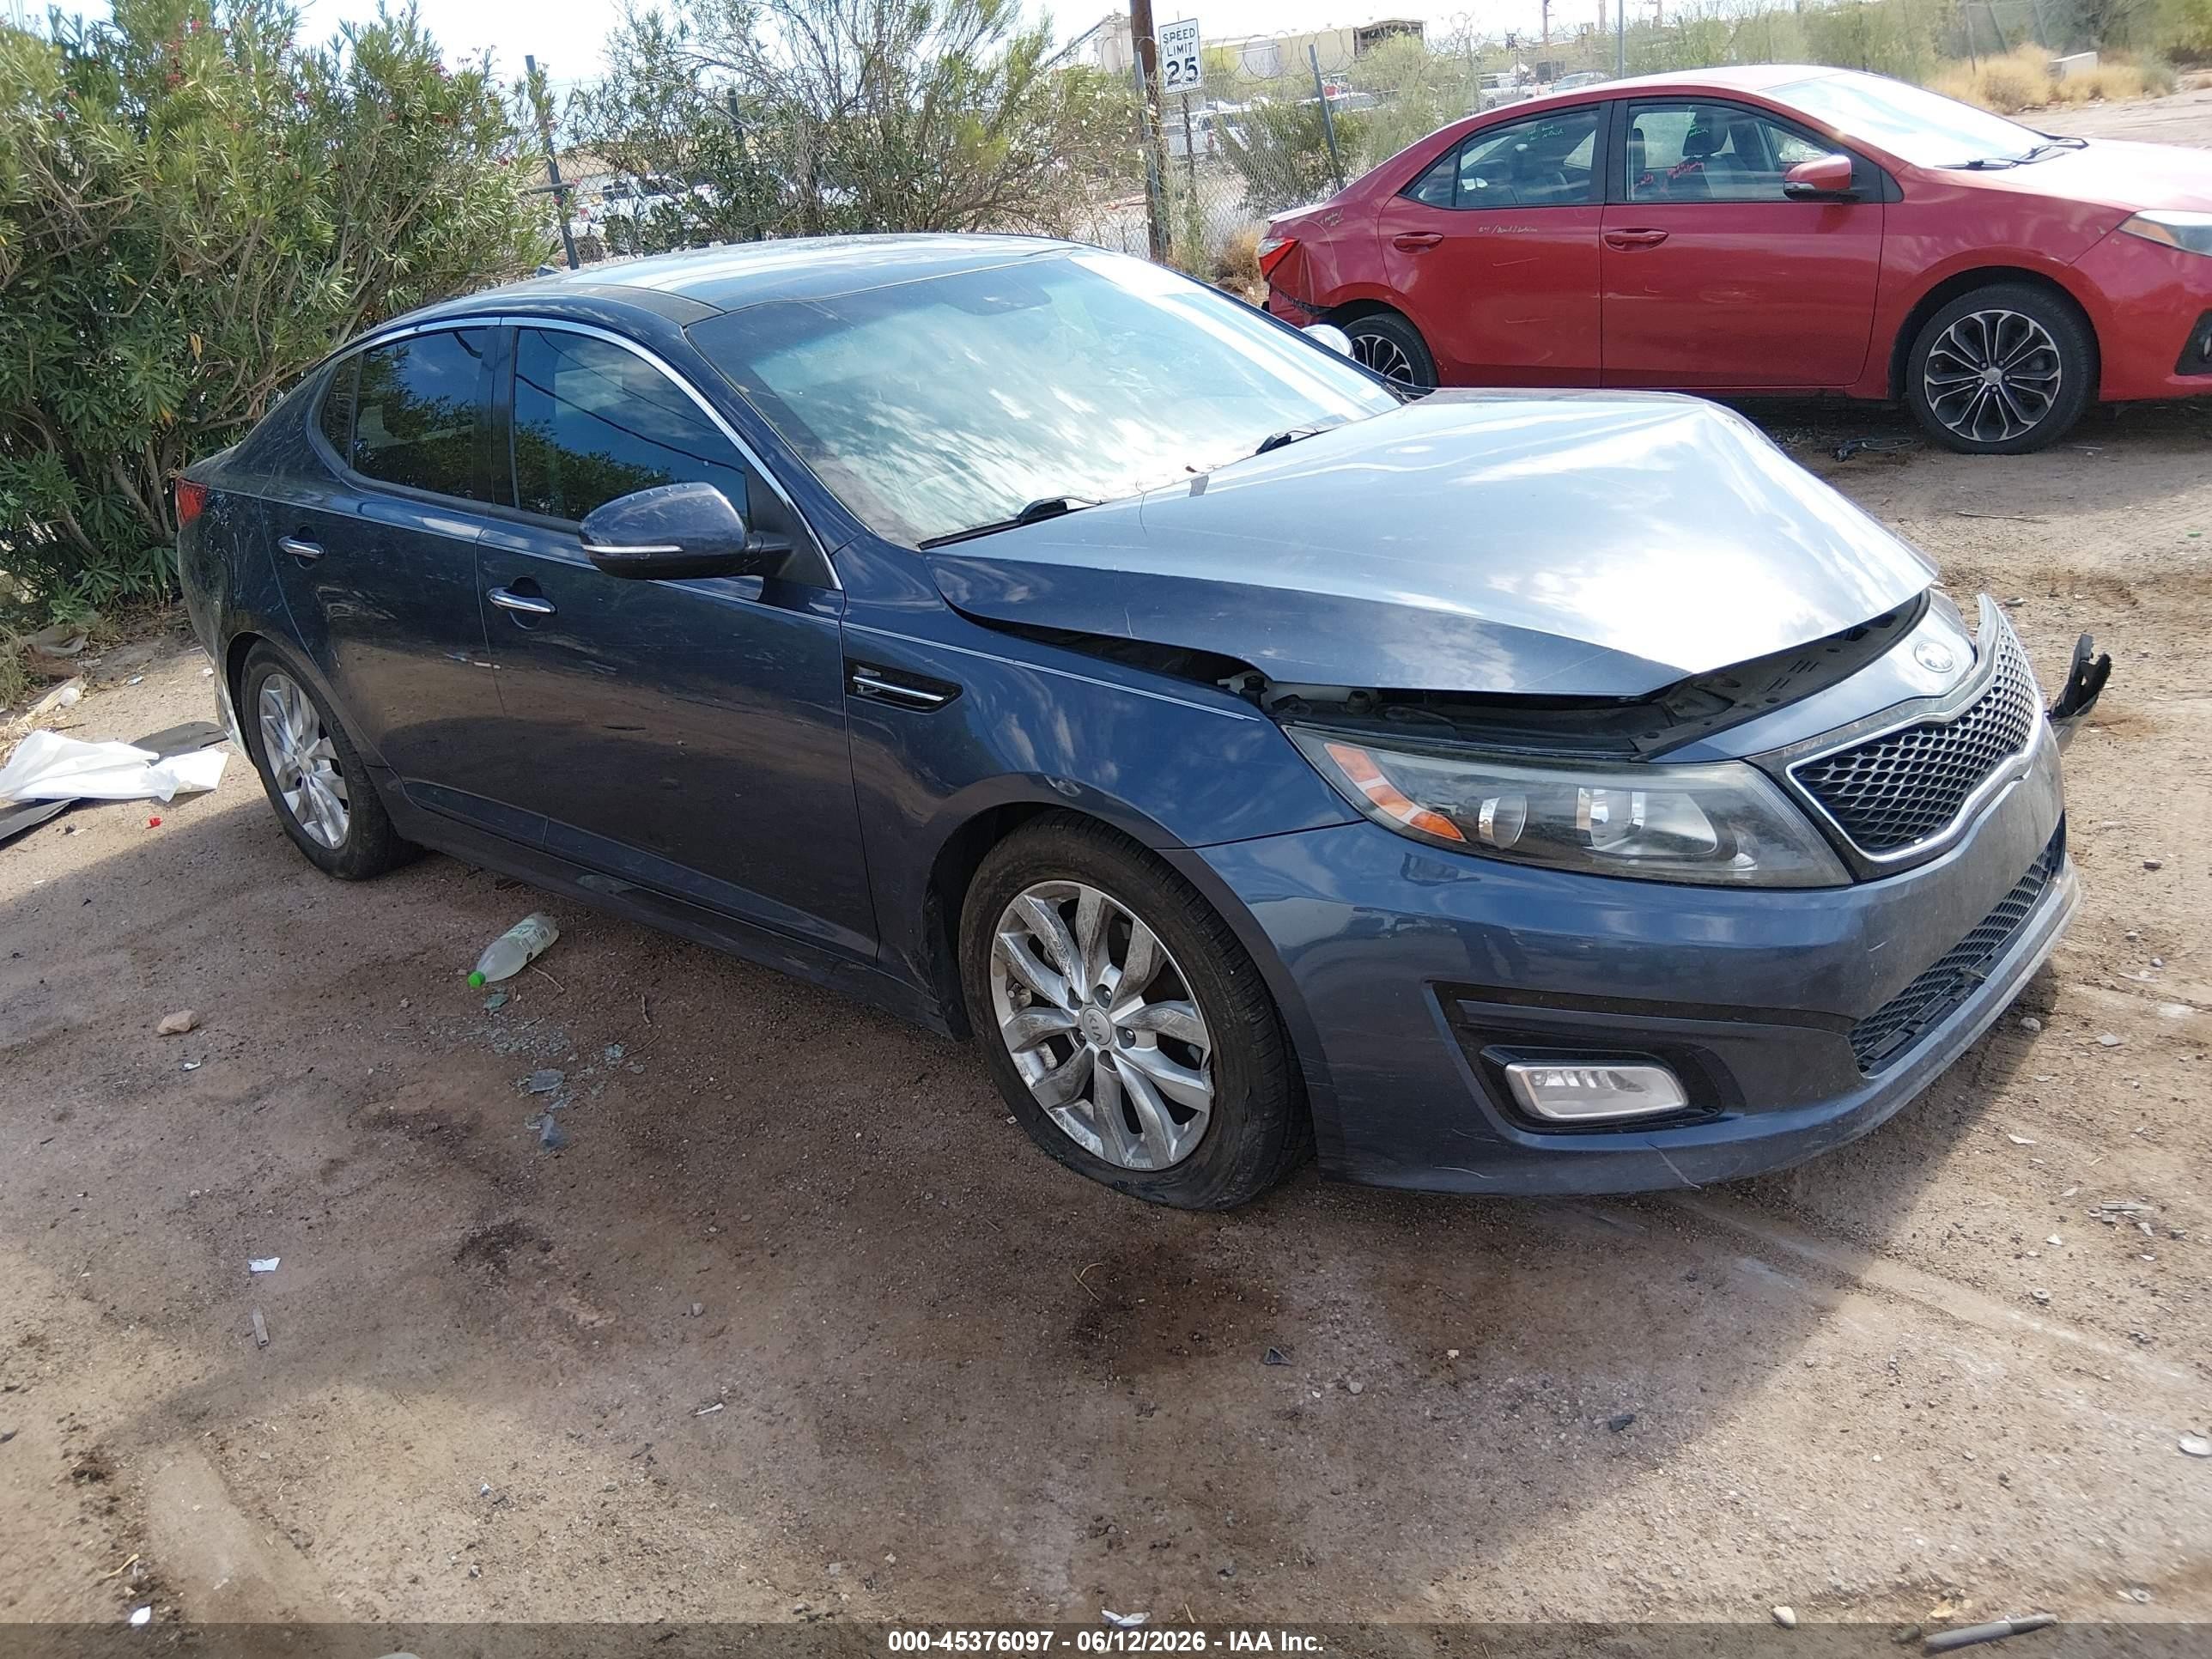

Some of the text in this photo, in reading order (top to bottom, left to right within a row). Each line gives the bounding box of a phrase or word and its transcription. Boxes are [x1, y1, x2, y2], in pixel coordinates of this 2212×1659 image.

[1163, 27, 1196, 44] SPEED
[1167, 42, 1194, 57] LIMIT
[1166, 57, 1199, 86] 25
